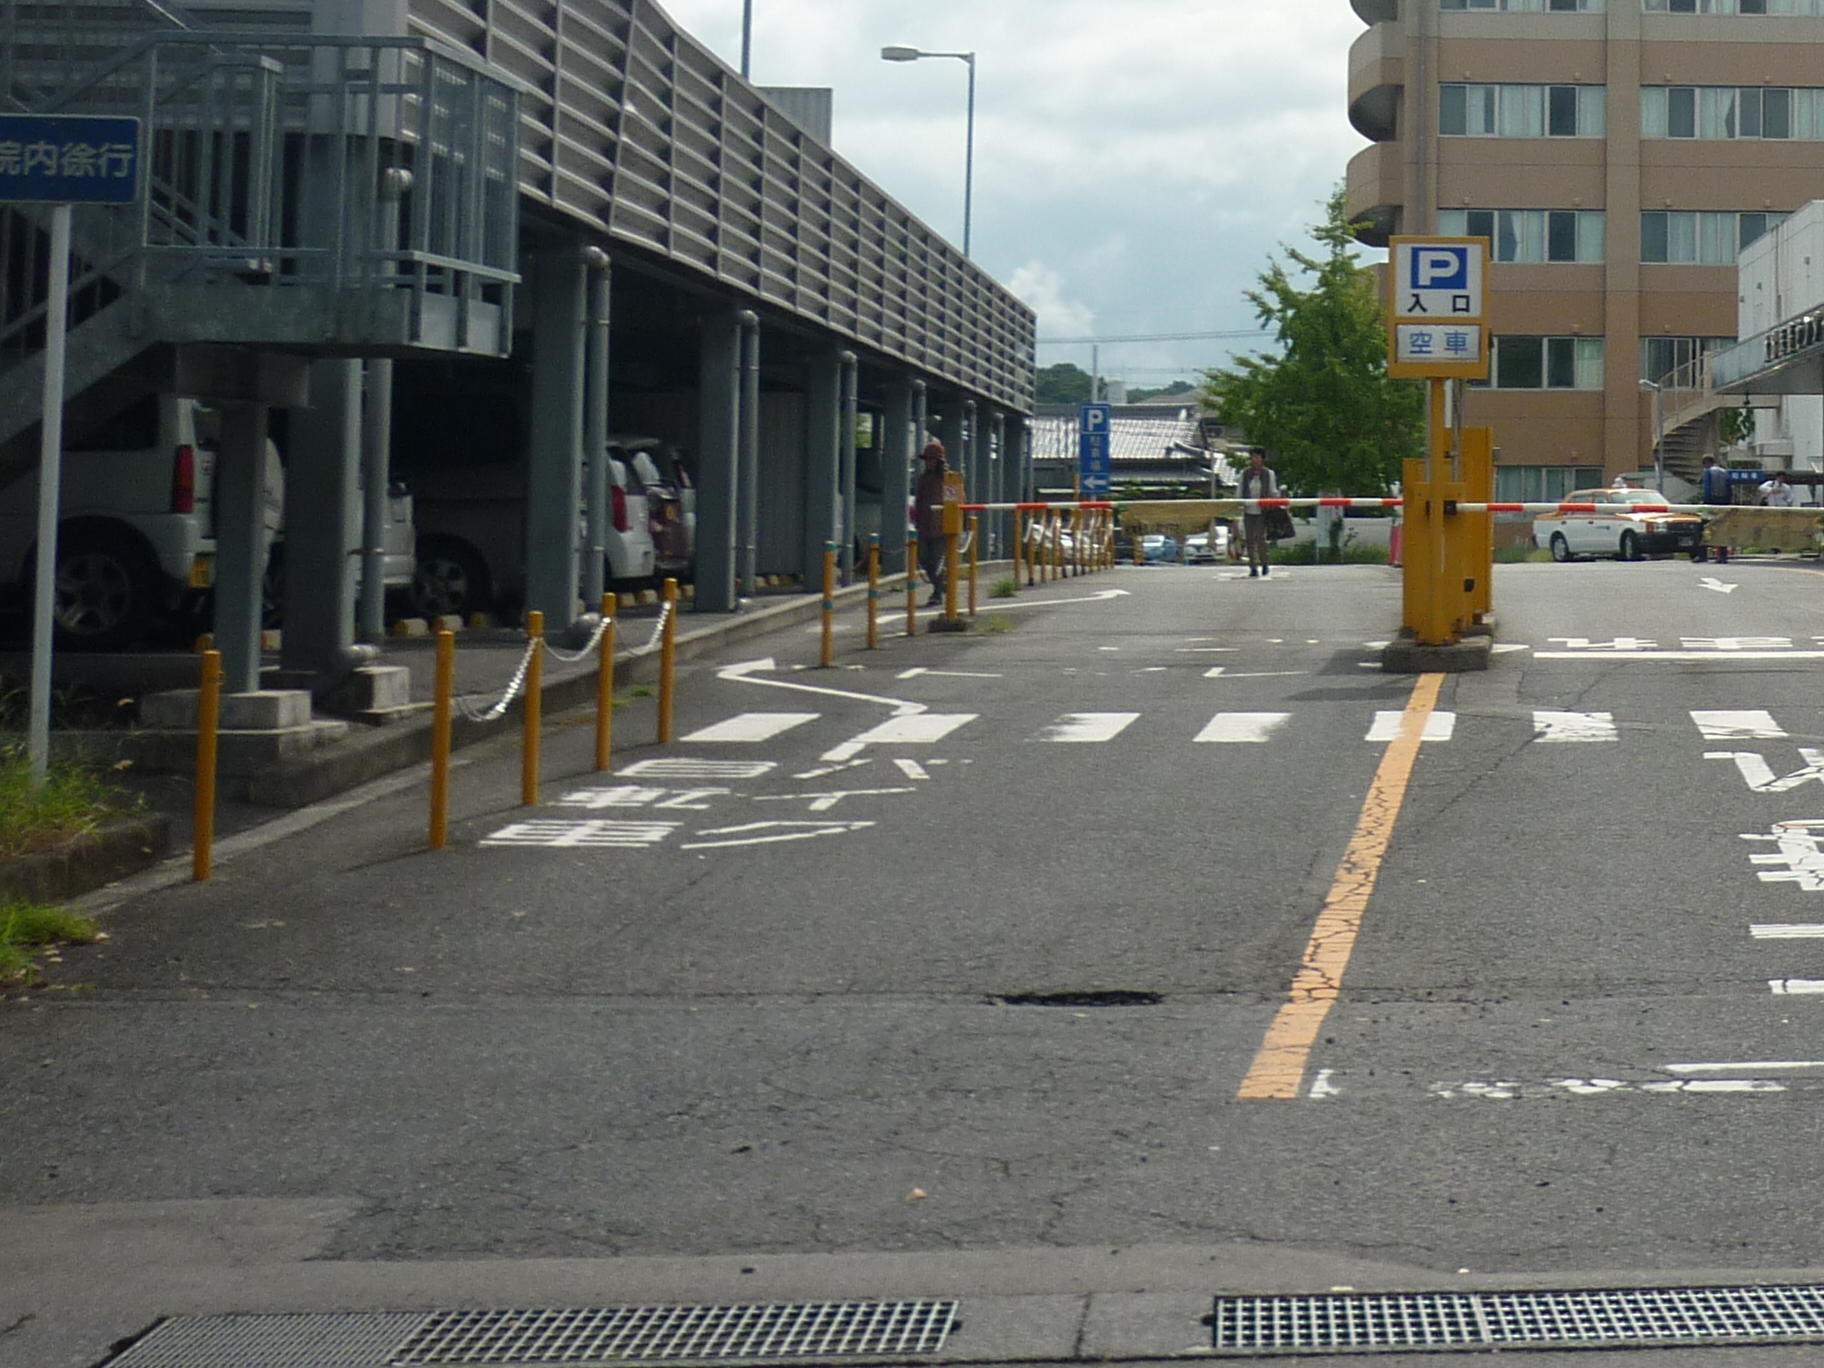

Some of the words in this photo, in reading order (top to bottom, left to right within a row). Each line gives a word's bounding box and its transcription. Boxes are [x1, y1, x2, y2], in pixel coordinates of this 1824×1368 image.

[1418, 250, 1460, 287] P
[1407, 293, 1471, 313] 入口
[1409, 330, 1470, 356] 空車
[1087, 409, 1103, 431] P
[478, 757, 778, 847] 自転車
[681, 758, 949, 849] バイク
